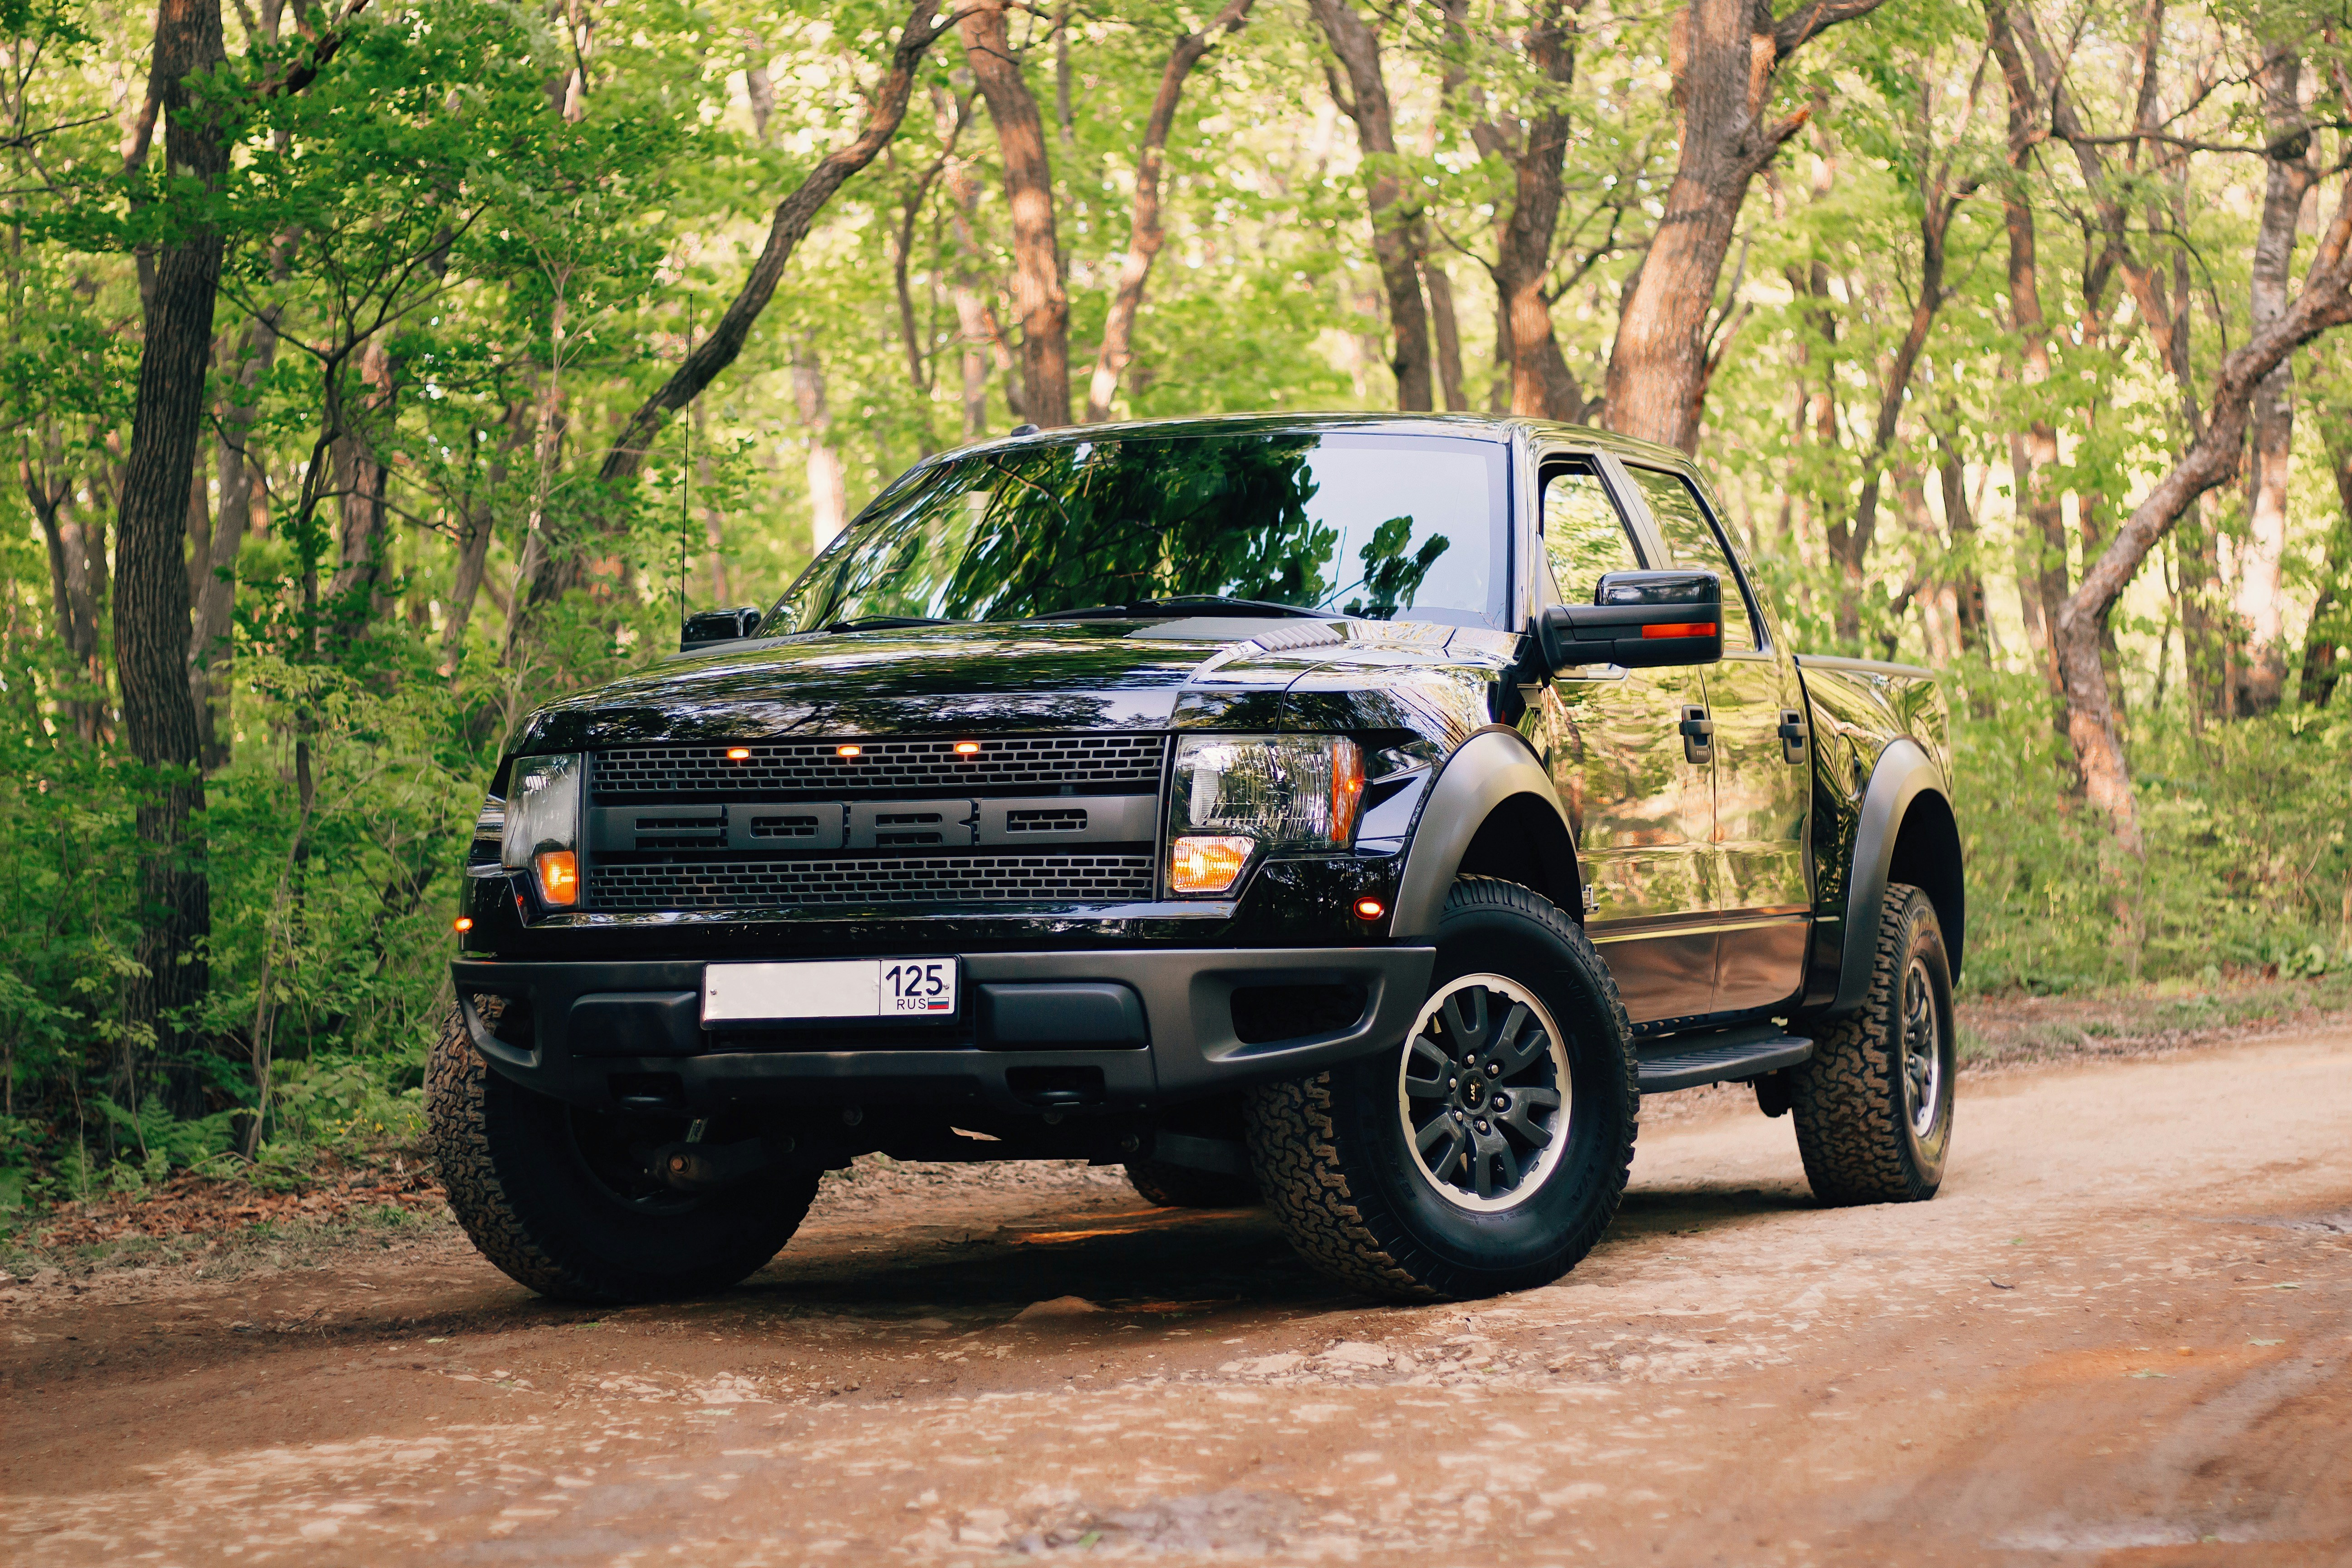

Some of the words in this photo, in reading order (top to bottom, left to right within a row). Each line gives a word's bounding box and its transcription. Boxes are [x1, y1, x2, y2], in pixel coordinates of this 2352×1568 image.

[589, 794, 1158, 852] FORD
[886, 965, 943, 996] 125
[897, 998, 926, 1010] RUS
